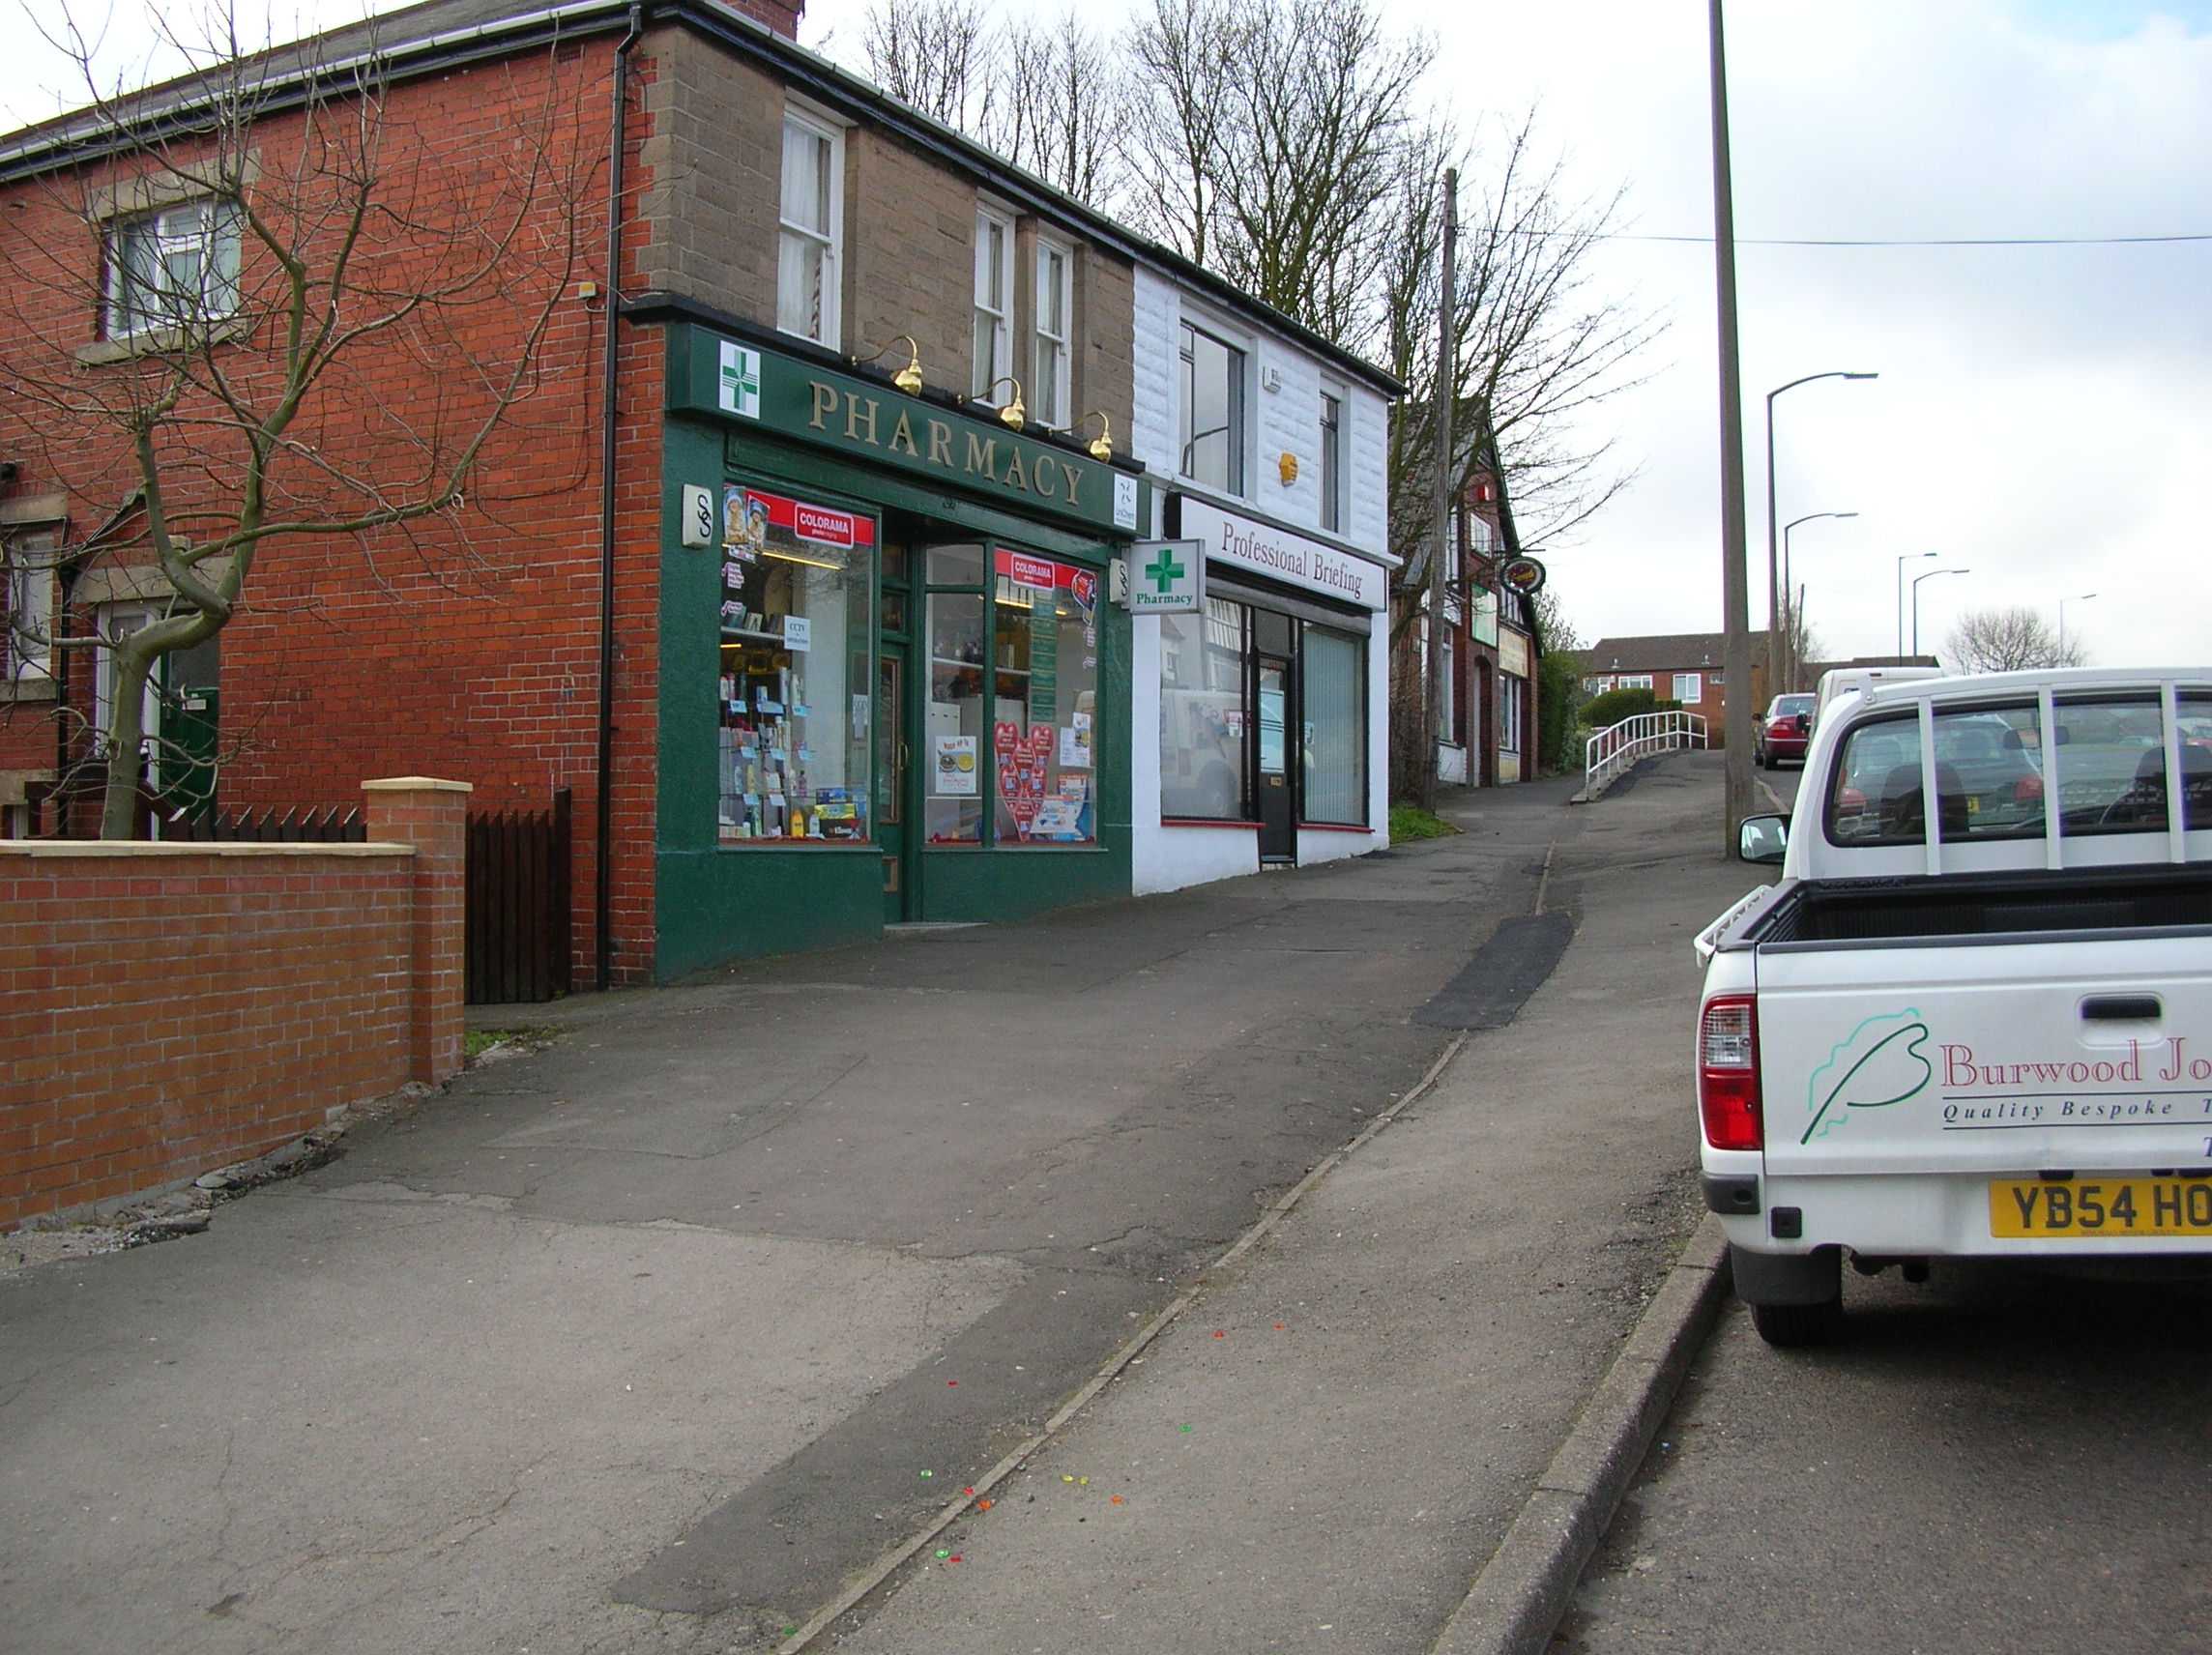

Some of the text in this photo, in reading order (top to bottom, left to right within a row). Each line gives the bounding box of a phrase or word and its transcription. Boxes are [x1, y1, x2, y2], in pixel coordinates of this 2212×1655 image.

[808, 380, 1085, 507] PHARMACY
[800, 512, 849, 534] COLORAMA
[1014, 562, 1052, 579] COLORAMA
[1222, 521, 1362, 599] Professional Briefing
[1136, 593, 1193, 606] Pharmacy
[1938, 1038, 2142, 1088] Burwood
[1943, 1102, 2044, 1122] Quality
[2061, 1099, 2172, 1119] Bespoke
[2012, 1184, 2138, 1229] YB54
